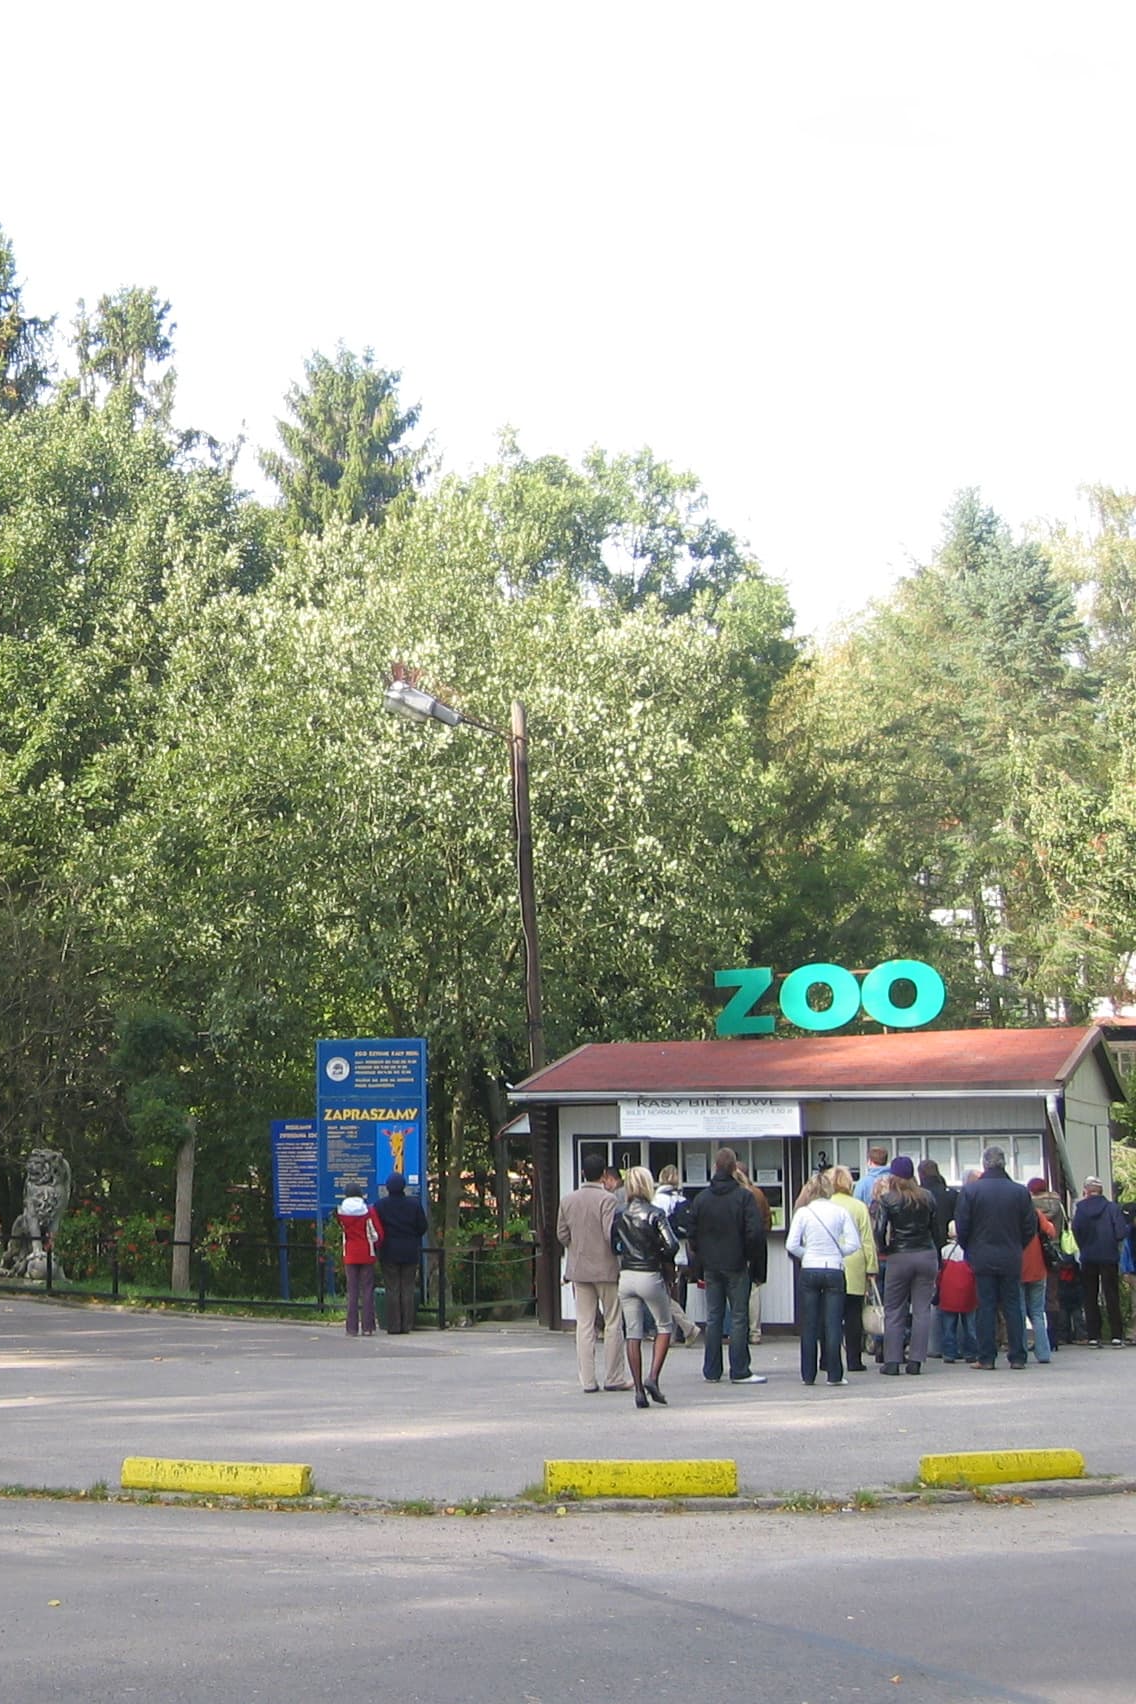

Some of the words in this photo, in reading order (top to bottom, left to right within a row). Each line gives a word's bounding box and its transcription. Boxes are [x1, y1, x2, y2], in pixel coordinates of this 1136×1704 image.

[714, 959, 946, 1035] ZOO
[637, 1097, 682, 1107] KASY
[324, 1108, 418, 1121] ZAPRASZAMY
[818, 1150, 826, 1168] 3
